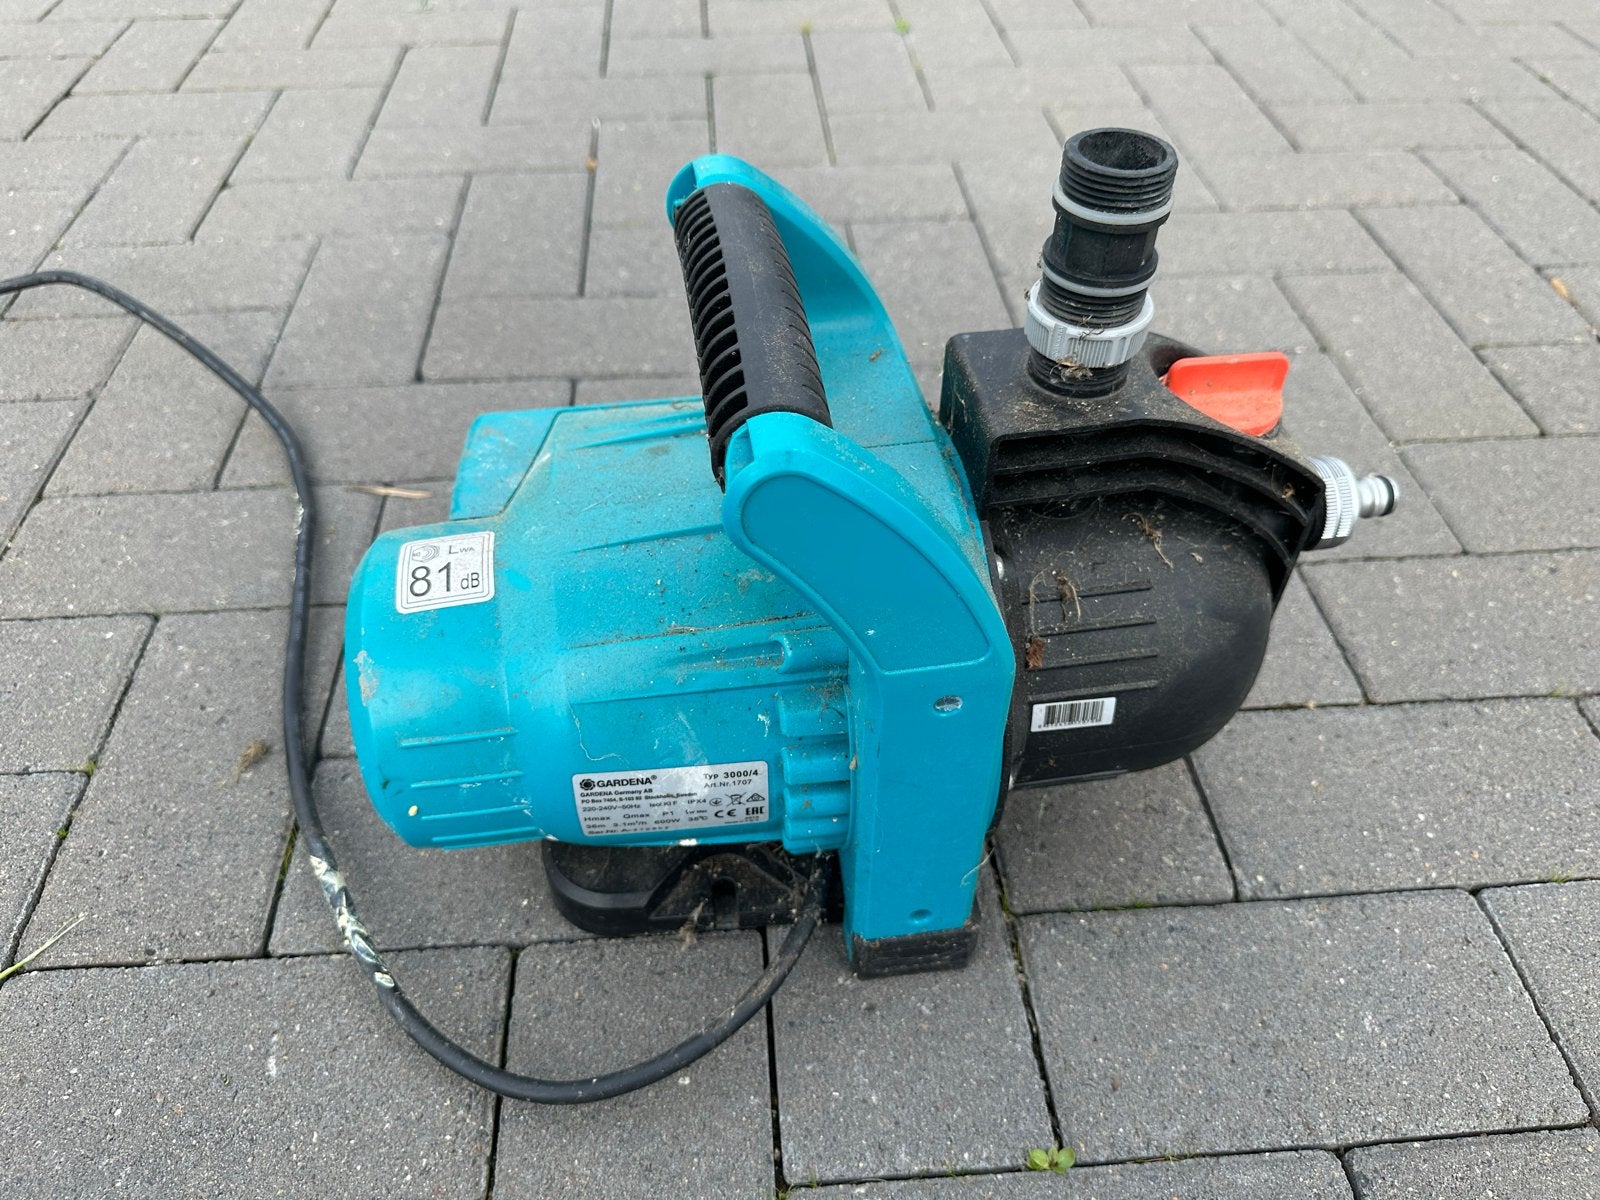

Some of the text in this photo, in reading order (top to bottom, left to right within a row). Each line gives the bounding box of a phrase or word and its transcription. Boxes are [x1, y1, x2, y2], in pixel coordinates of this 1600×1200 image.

[409, 562, 480, 597] 81 dB
[723, 769, 759, 779] 3000/4
[580, 790, 613, 798] GARDENA
[614, 788, 642, 796] Germany
[745, 806, 766, 816] EAC
